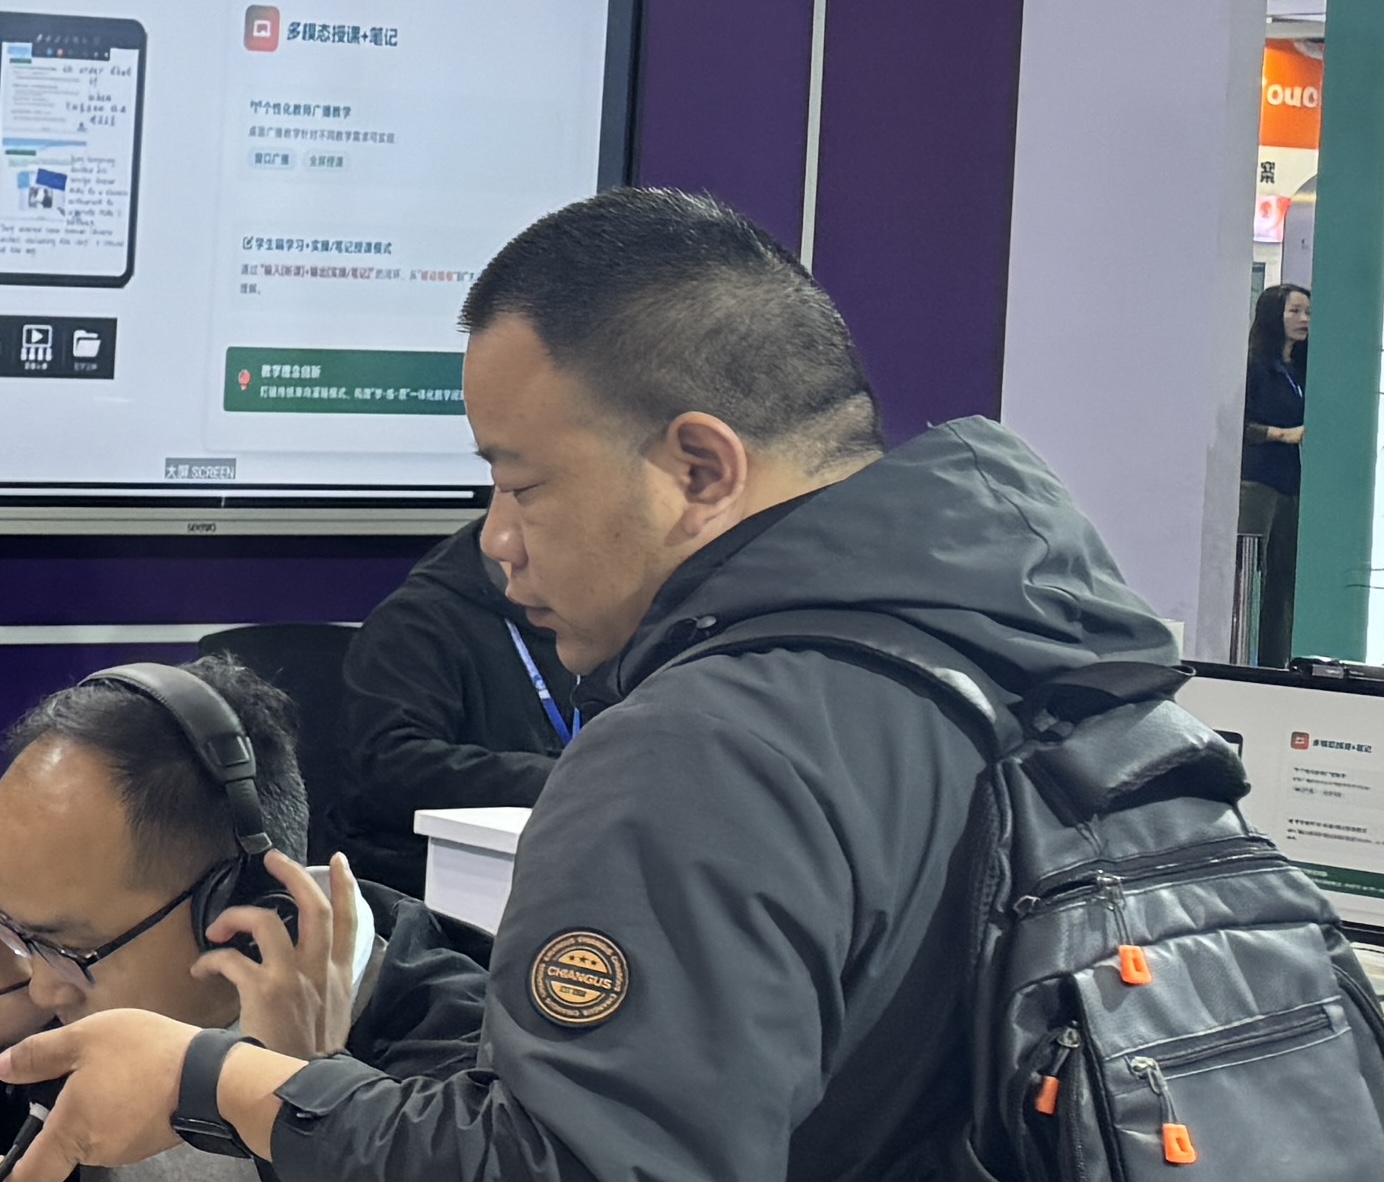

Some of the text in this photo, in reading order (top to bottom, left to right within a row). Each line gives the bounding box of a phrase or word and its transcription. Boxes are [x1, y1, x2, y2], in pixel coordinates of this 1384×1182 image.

[287, 22, 399, 47] 多模态授课+笔记
[191, 465, 235, 480] SCREEN
